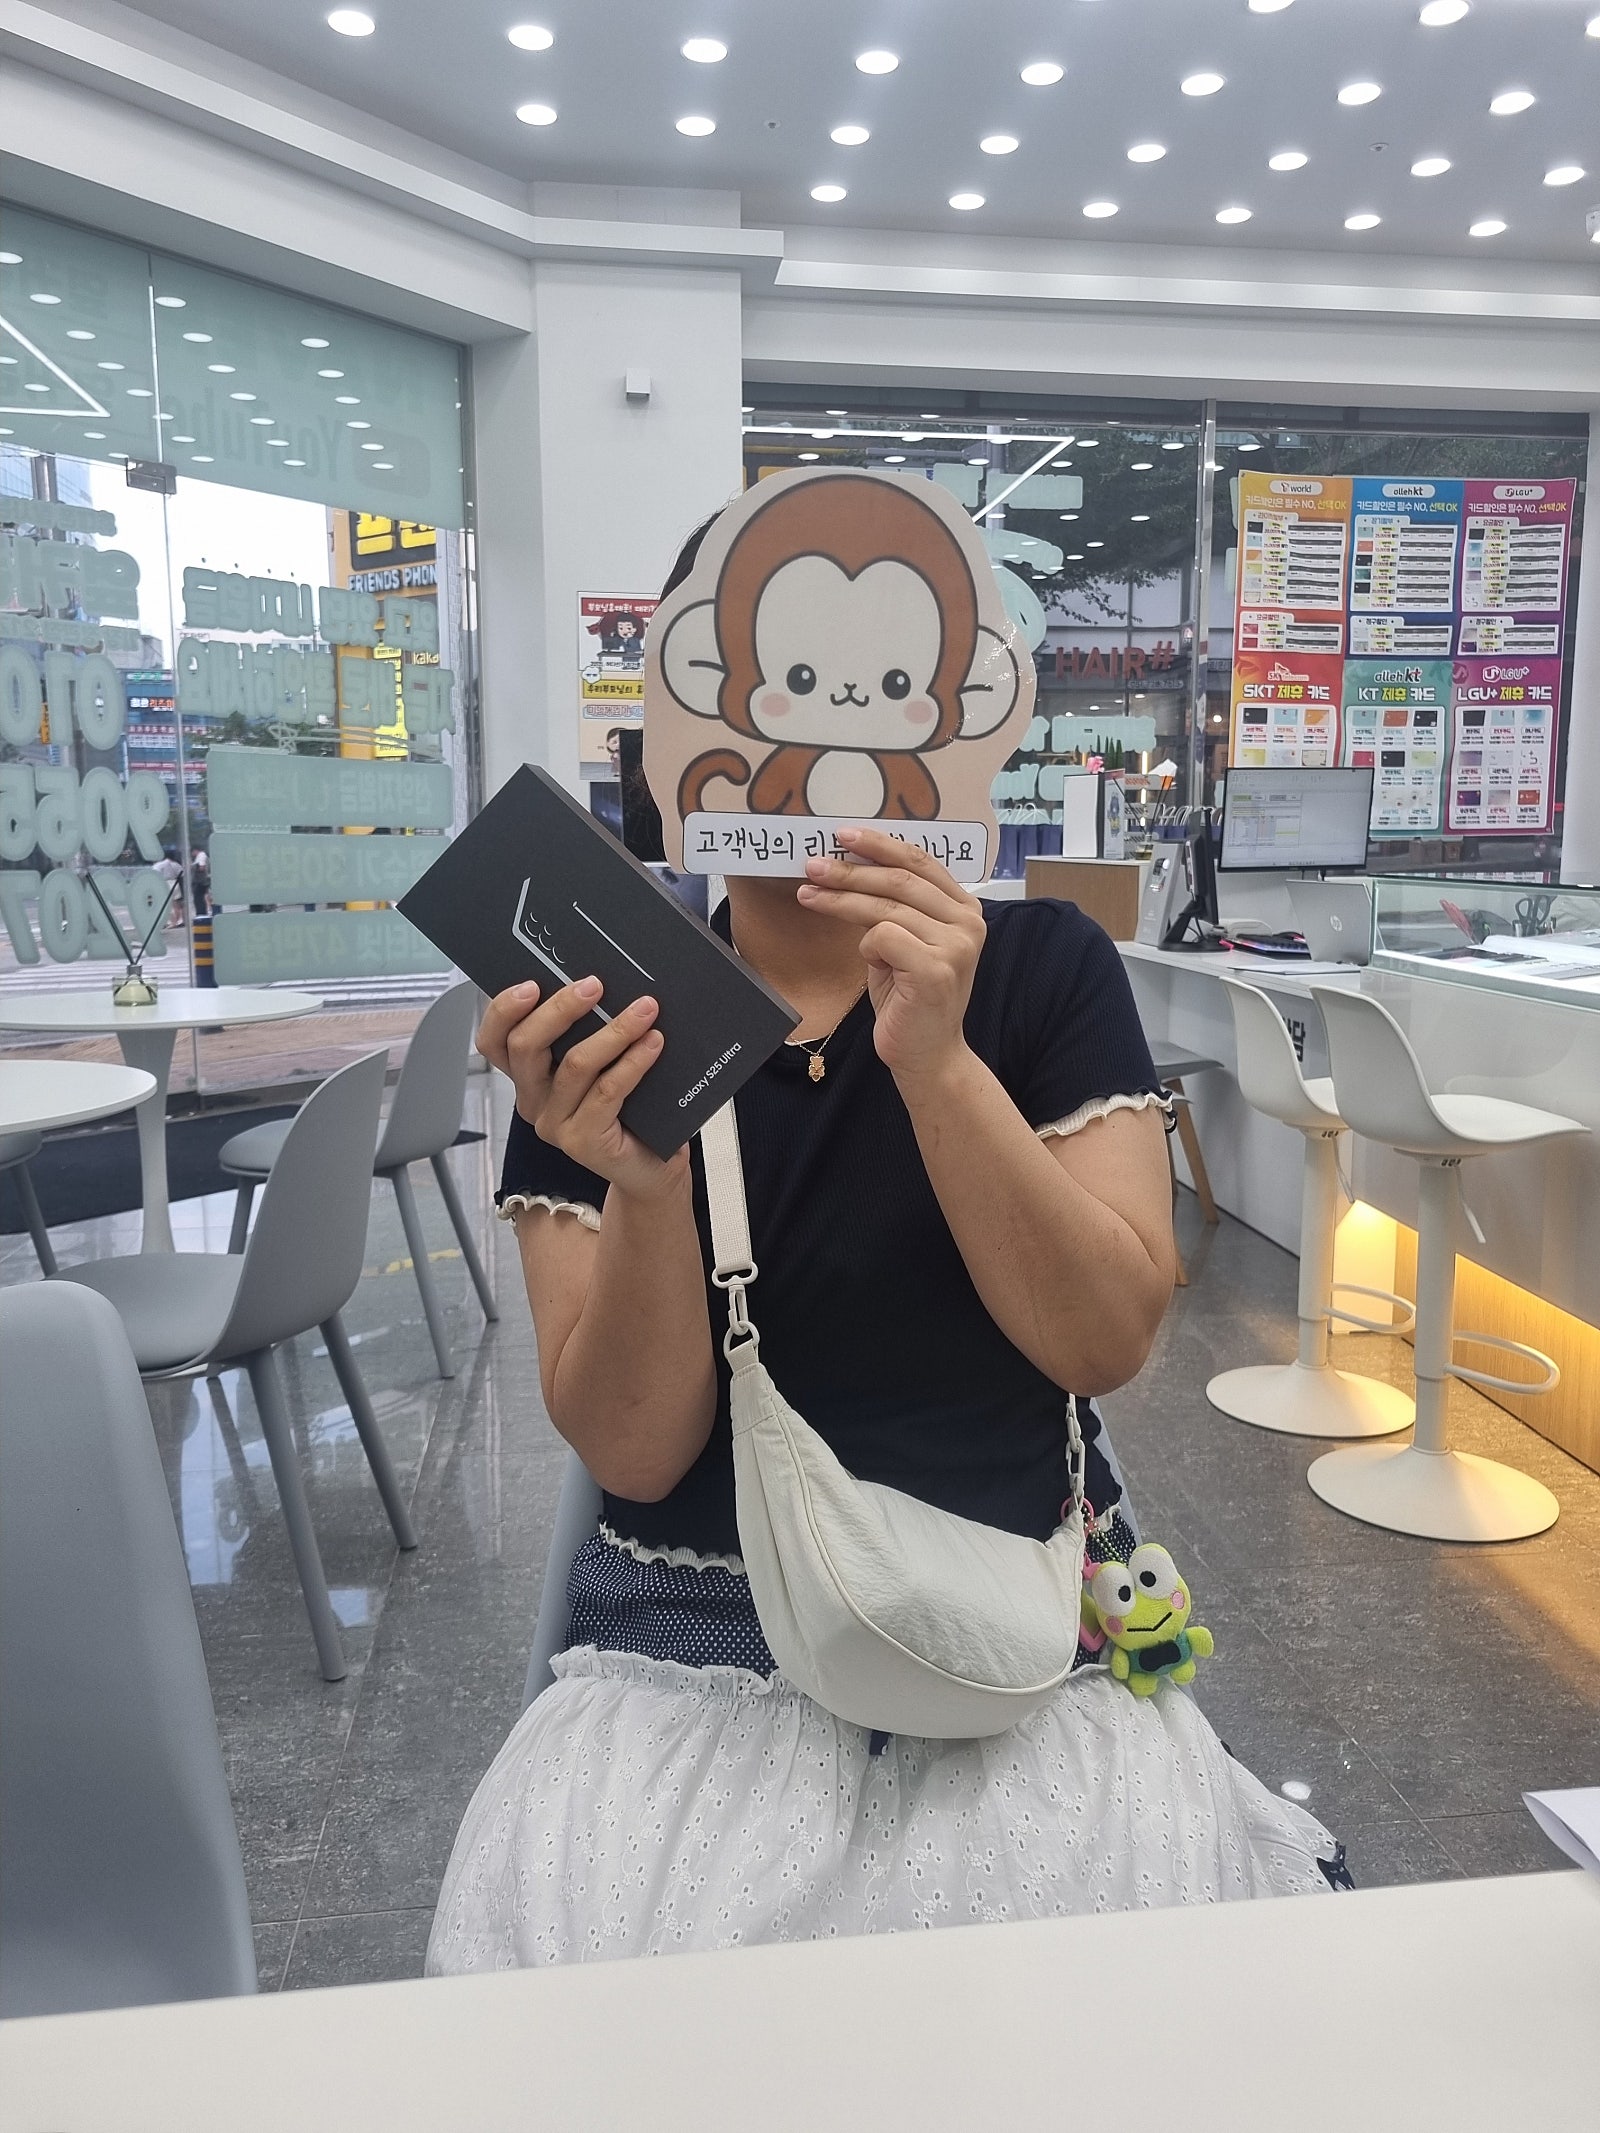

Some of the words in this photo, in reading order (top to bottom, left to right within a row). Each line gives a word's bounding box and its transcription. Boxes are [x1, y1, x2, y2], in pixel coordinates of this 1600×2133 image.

[1290, 485, 1311, 493] world
[1413, 487, 1423, 495] kt
[1246, 496, 1284, 508] 카드할인은
[1285, 499, 1300, 508] 필수
[1318, 500, 1334, 509] 선택
[1335, 501, 1346, 509] OK
[1357, 501, 1395, 511] 카드할인은
[1397, 502, 1413, 512] 필수
[1429, 502, 1445, 512] 선택
[1446, 503, 1457, 512] OK
[1469, 503, 1507, 513] 카드할인은
[1508, 504, 1523, 513] 필수
[1539, 503, 1555, 513] 선택
[1556, 503, 1566, 511] OK
[348, 570, 401, 593] FRIENDS
[1375, 671, 1402, 683] olleh
[1403, 667, 1421, 683] kt
[1244, 684, 1275, 698] SKT
[1277, 684, 1303, 699] 제휴
[1308, 685, 1330, 700] 카드
[1358, 687, 1379, 700] KT
[1382, 687, 1407, 701] 제휴
[1410, 687, 1434, 701] 카드
[1457, 688, 1498, 700] LGU+
[1500, 687, 1524, 701] 제휴
[1528, 686, 1552, 700] 카드
[696, 827, 794, 862] 고객님의
[678, 1076, 709, 1108] Galaxy
[706, 1062, 722, 1079] S25
[720, 1042, 742, 1064] Ultra
